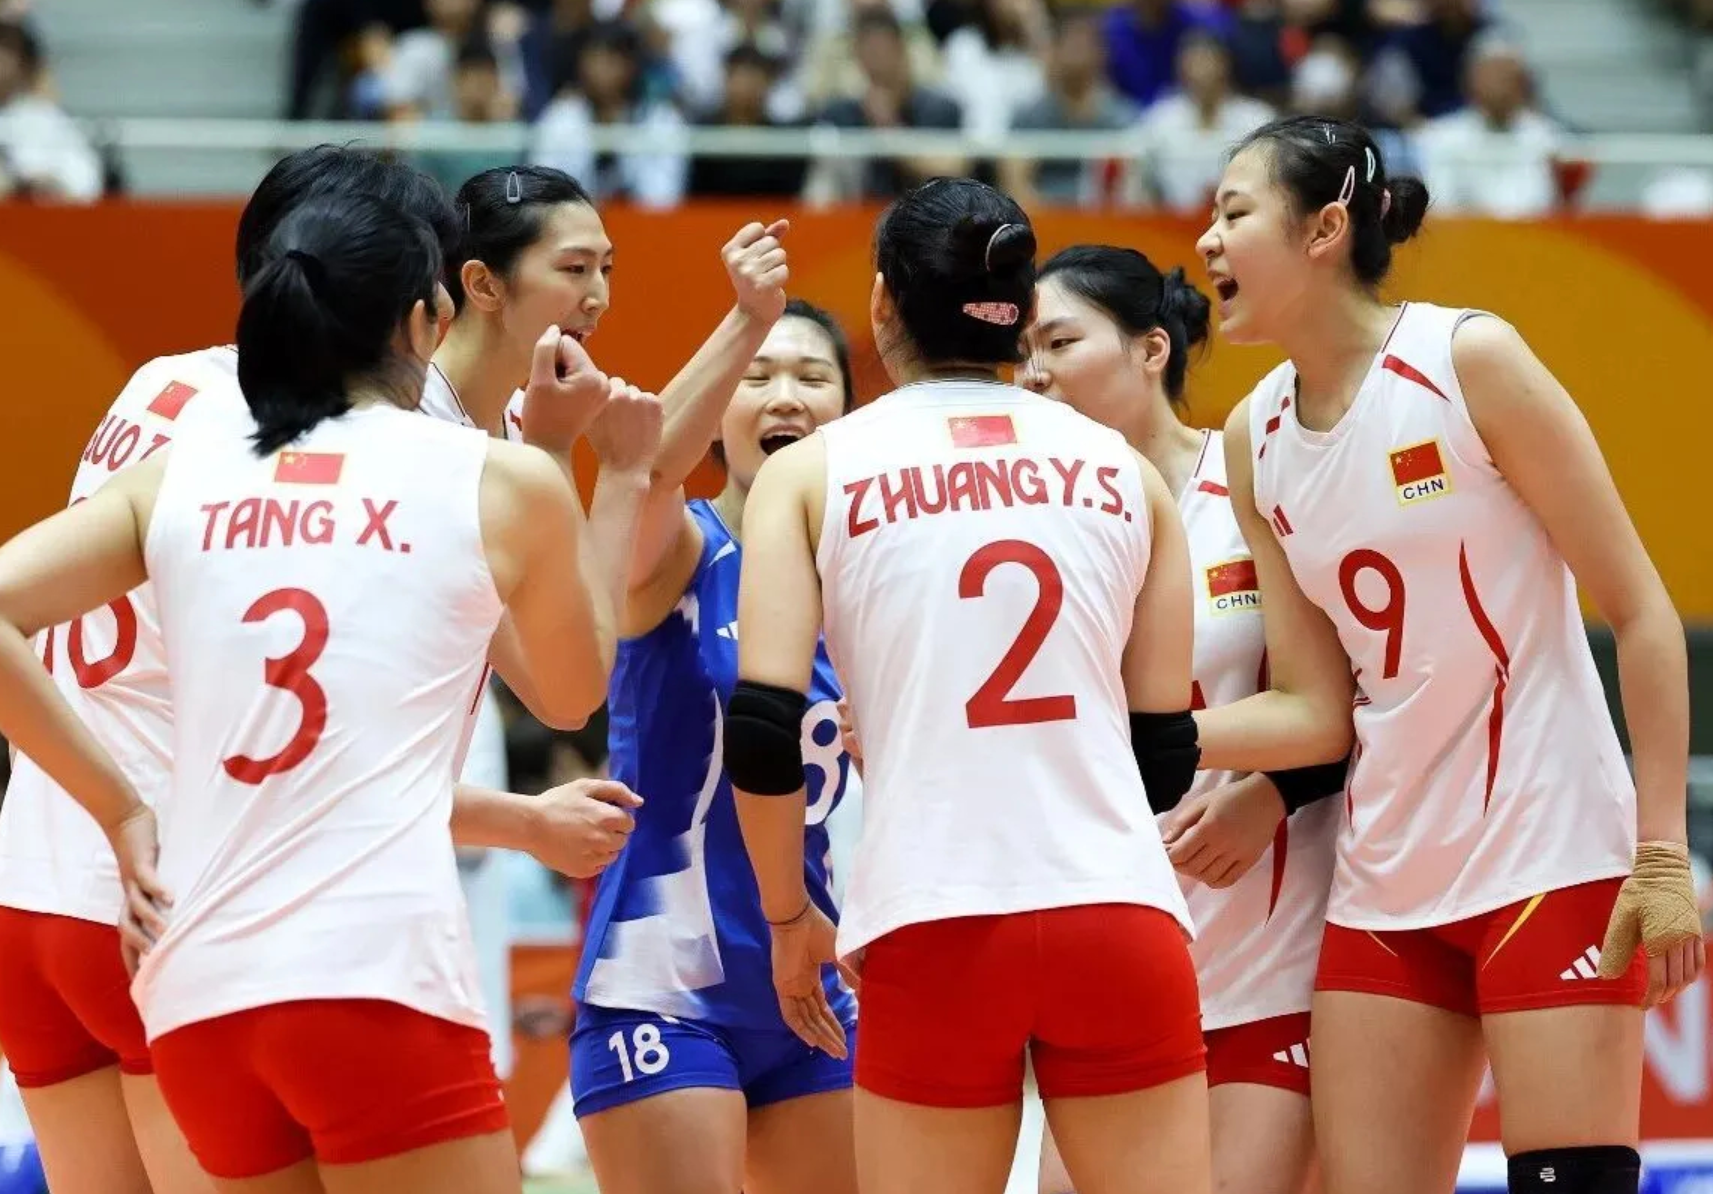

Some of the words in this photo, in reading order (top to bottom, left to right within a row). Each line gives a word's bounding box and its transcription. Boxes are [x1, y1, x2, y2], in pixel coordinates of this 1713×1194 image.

[1403, 478, 1444, 500] CHN
[200, 497, 336, 552] TANG
[356, 497, 411, 553] X.
[1216, 592, 1257, 610] CHN
[1338, 547, 1406, 680] 9
[957, 539, 1077, 729] 2
[222, 586, 330, 785] 3
[608, 1023, 670, 1083] 18
